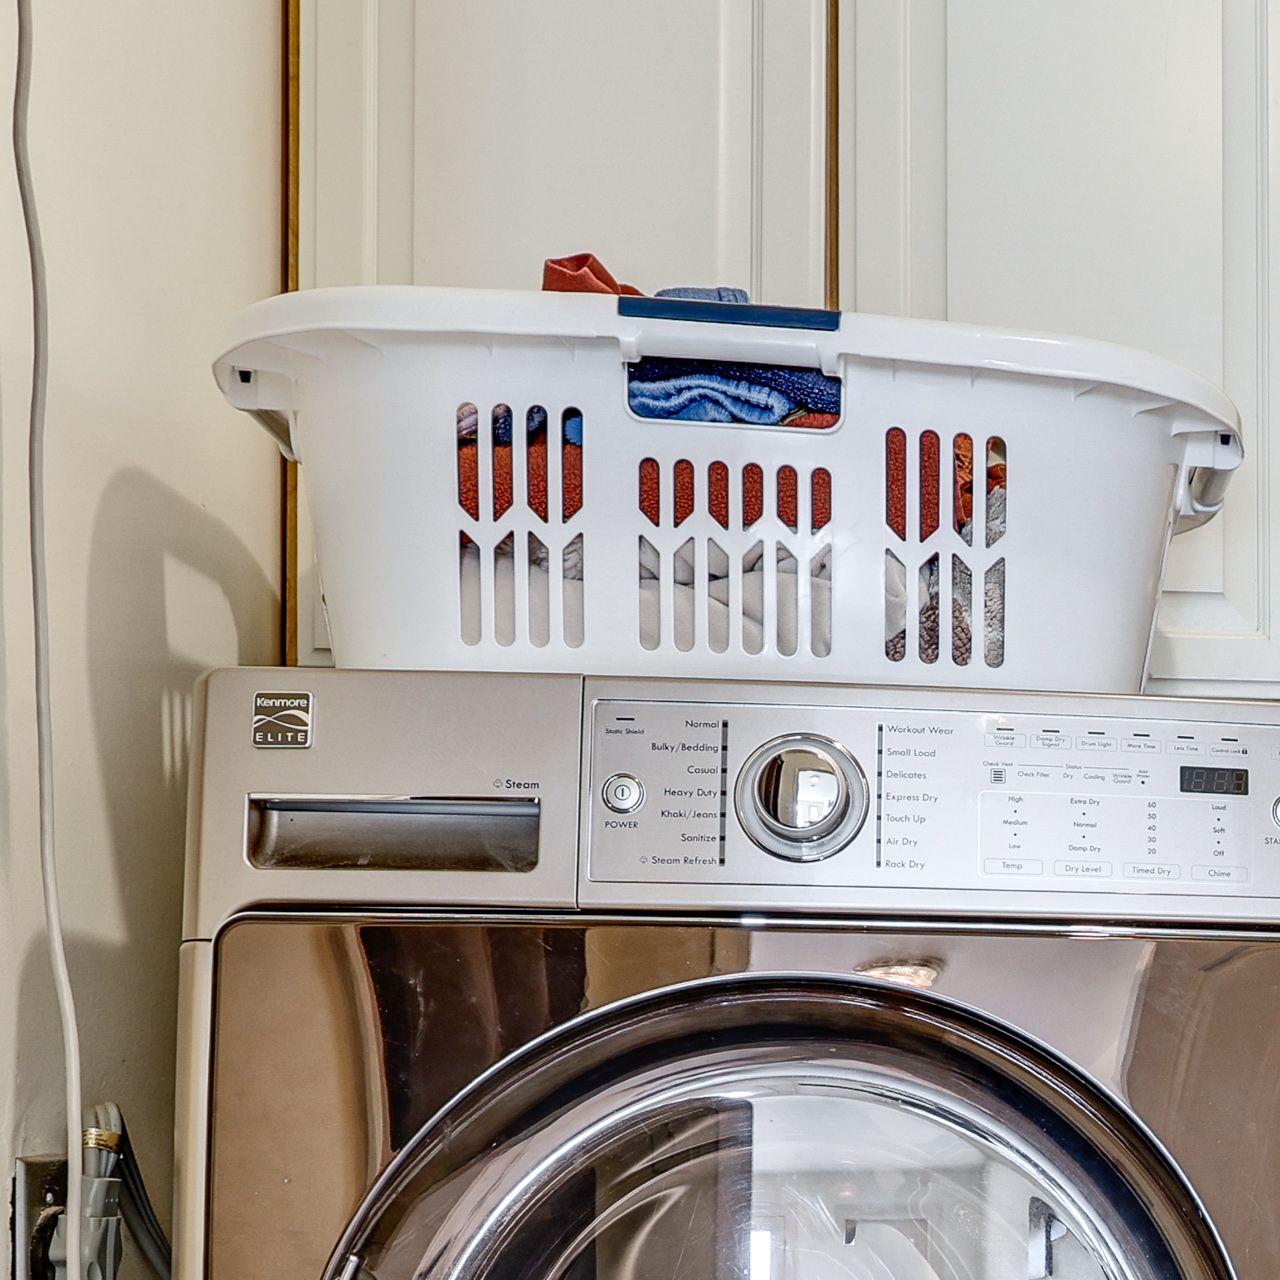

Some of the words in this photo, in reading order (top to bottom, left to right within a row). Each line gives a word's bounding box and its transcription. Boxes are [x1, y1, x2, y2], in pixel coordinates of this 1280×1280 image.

[257, 698, 307, 706] Kenmore
[685, 720, 719, 728] Normal
[887, 726, 926, 734] Workout
[928, 727, 954, 735] Wear
[256, 733, 306, 742] ELITE
[651, 743, 718, 753] Bulky/Bedding
[887, 748, 910, 757] Small
[914, 749, 936, 758] Load
[687, 766, 718, 774] Casual
[886, 771, 926, 780] Delicates
[1084, 773, 1105, 781] Cooling
[505, 779, 540, 790] Steam
[664, 788, 693, 798] Heavy
[697, 788, 718, 798] Duty
[886, 793, 920, 802] Express
[922, 794, 938, 803] Dry
[1088, 798, 1100, 806] Dry
[661, 810, 718, 819] Khaki/Jeans
[886, 814, 910, 822] Touch
[913, 815, 926, 824] Up
[681, 834, 717, 842] Sanitize
[886, 838, 900, 846] Air
[902, 838, 918, 847] Dry
[652, 856, 680, 864] Steam
[684, 856, 717, 865] Refresh
[909, 861, 925, 870] Dry
[1002, 862, 1022, 870] Temp
[1065, 865, 1078, 873] Dry
[1132, 866, 1154, 874] Timed
[1158, 867, 1172, 876] Dry
[1208, 870, 1231, 878] Chime
